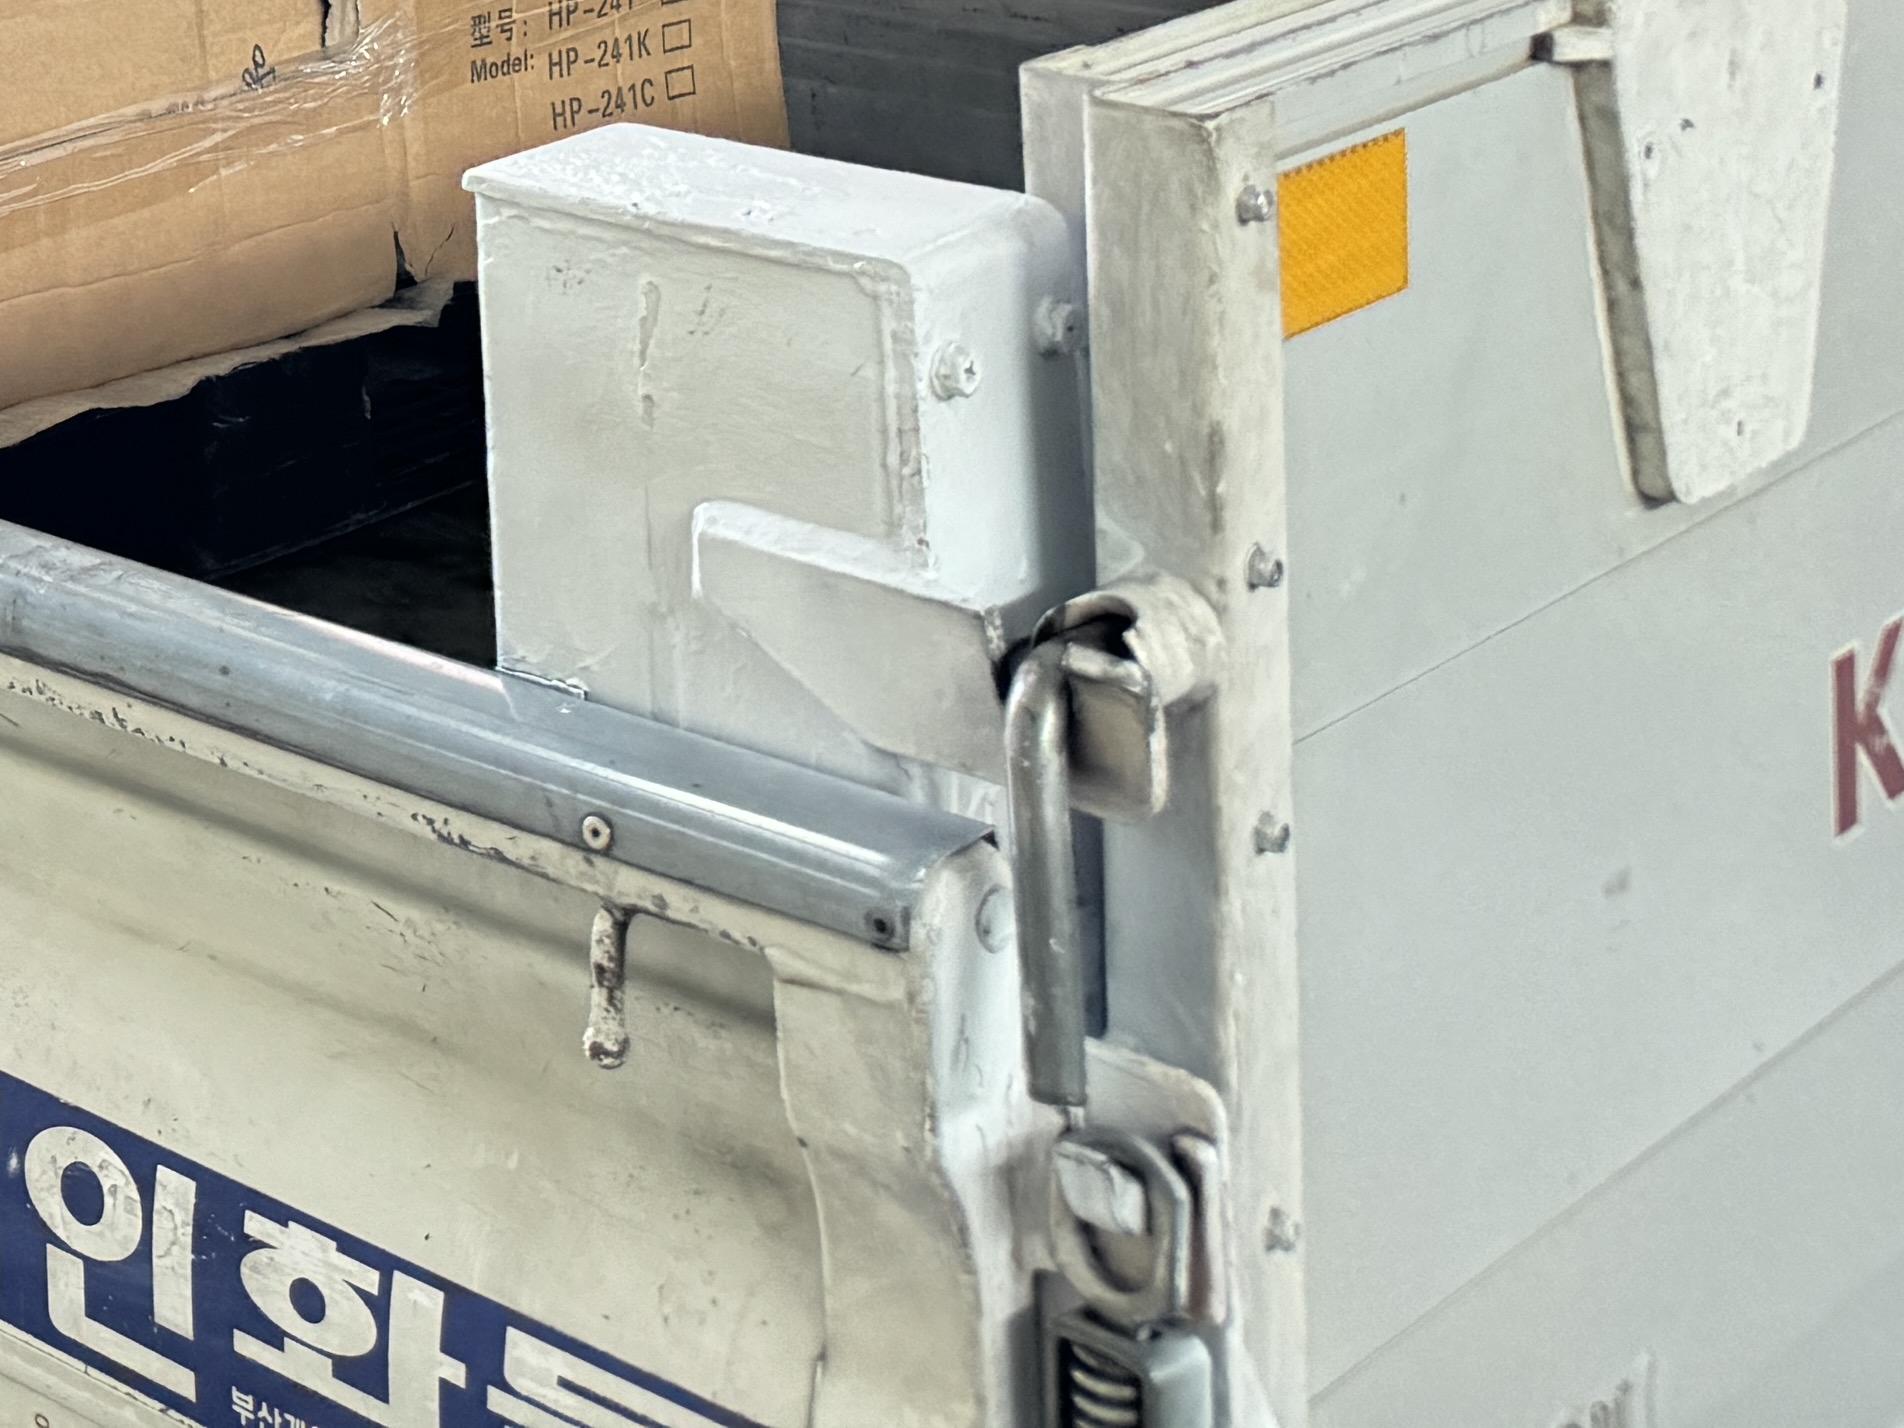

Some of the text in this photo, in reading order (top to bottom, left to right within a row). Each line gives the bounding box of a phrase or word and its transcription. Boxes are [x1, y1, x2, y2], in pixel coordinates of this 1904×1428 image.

[470, 28, 651, 84] Model: HP-241K
[551, 77, 655, 131] HP-241C
